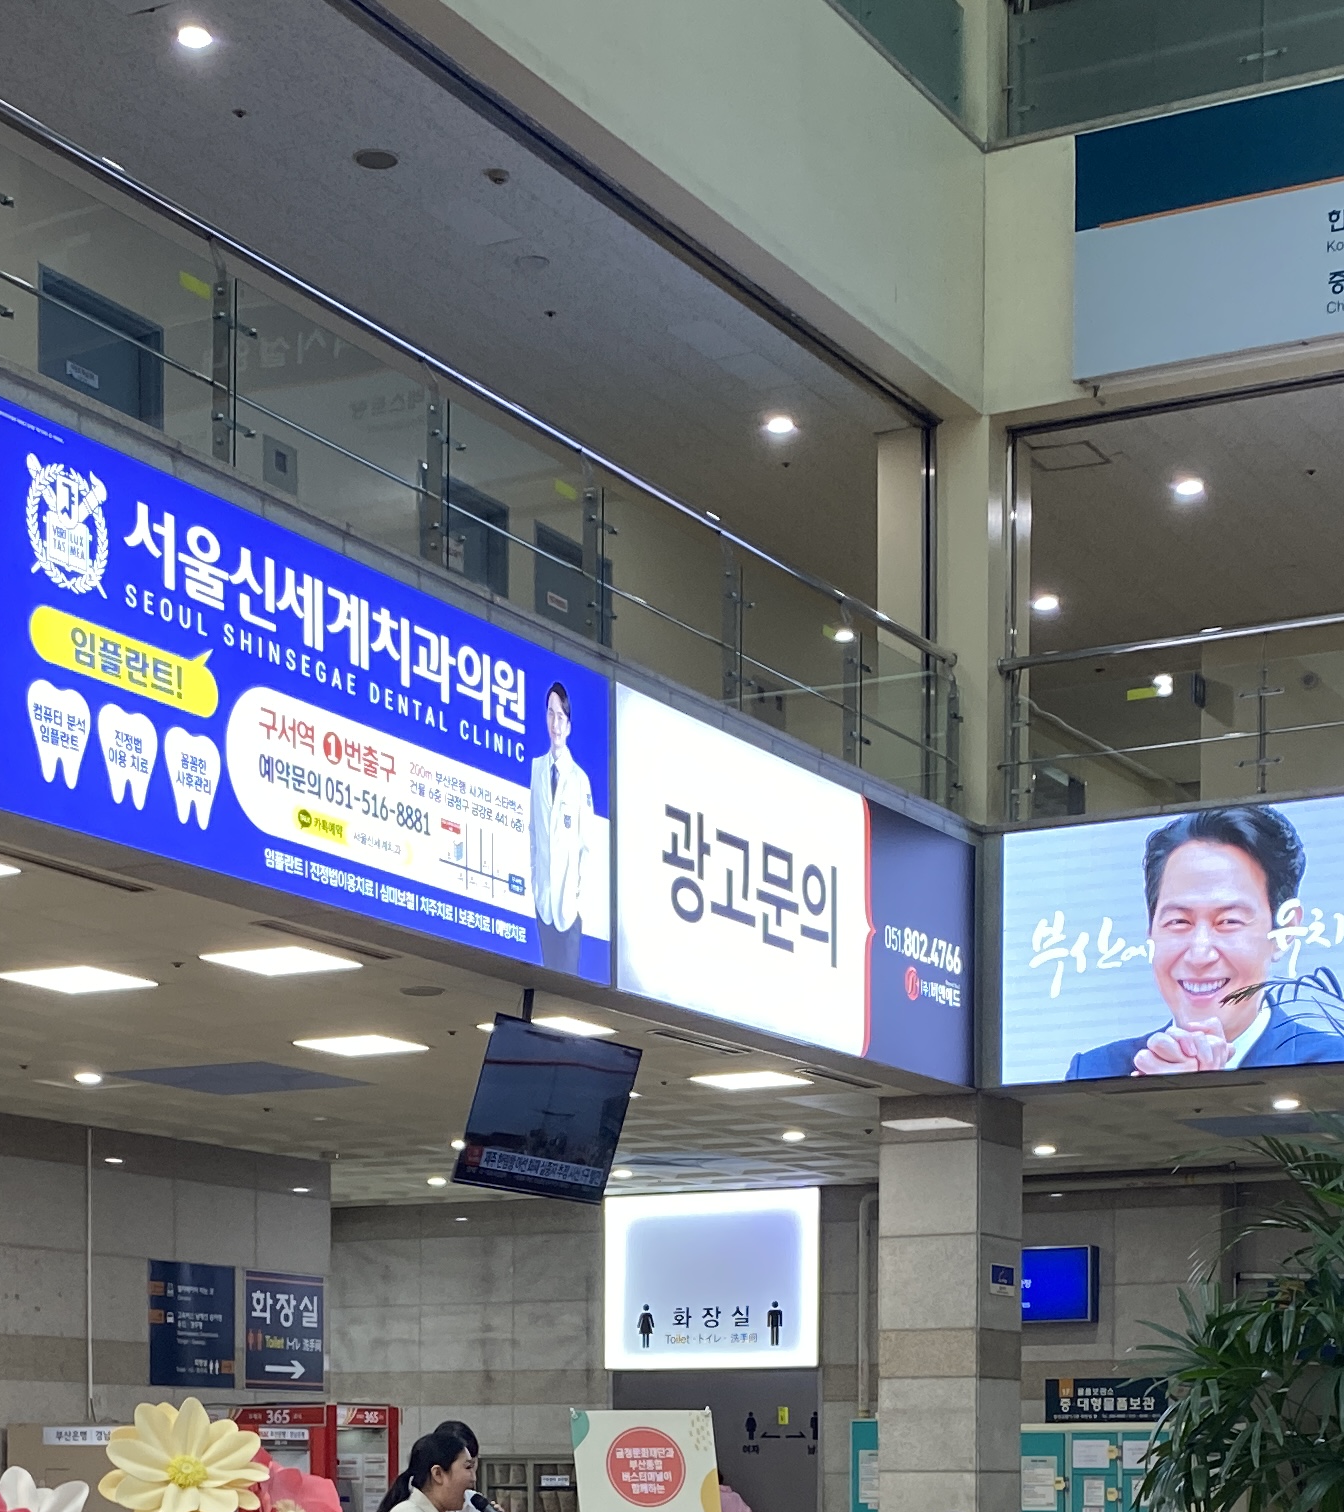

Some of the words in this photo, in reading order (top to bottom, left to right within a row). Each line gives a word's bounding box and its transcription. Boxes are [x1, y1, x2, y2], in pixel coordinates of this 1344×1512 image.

[123, 500, 527, 736] 서울신세계치과의원
[70, 627, 183, 700] 임플란트!
[124, 583, 208, 637] SEOUL
[223, 622, 358, 697] SHINSEGAE
[369, 682, 448, 733] DENTAL
[460, 719, 526, 764] CLINIC
[39, 725, 80, 752] 임플란트
[258, 706, 315, 756] 구서역
[258, 754, 322, 801] 예약문의
[325, 776, 431, 836] 051-516-8881
[264, 847, 304, 876] 임플란트
[309, 861, 375, 898] 진정법이용치료
[420, 895, 454, 923] 치주치료
[662, 803, 838, 969] 광고문의
[884, 924, 962, 975] 051.802.4766
[1028, 910, 1156, 999] 부산에
[251, 1290, 318, 1329] 화장실
[672, 1306, 750, 1329] 화장실
[265, 1409, 291, 1424] 365
[363, 1411, 379, 1424] 365
